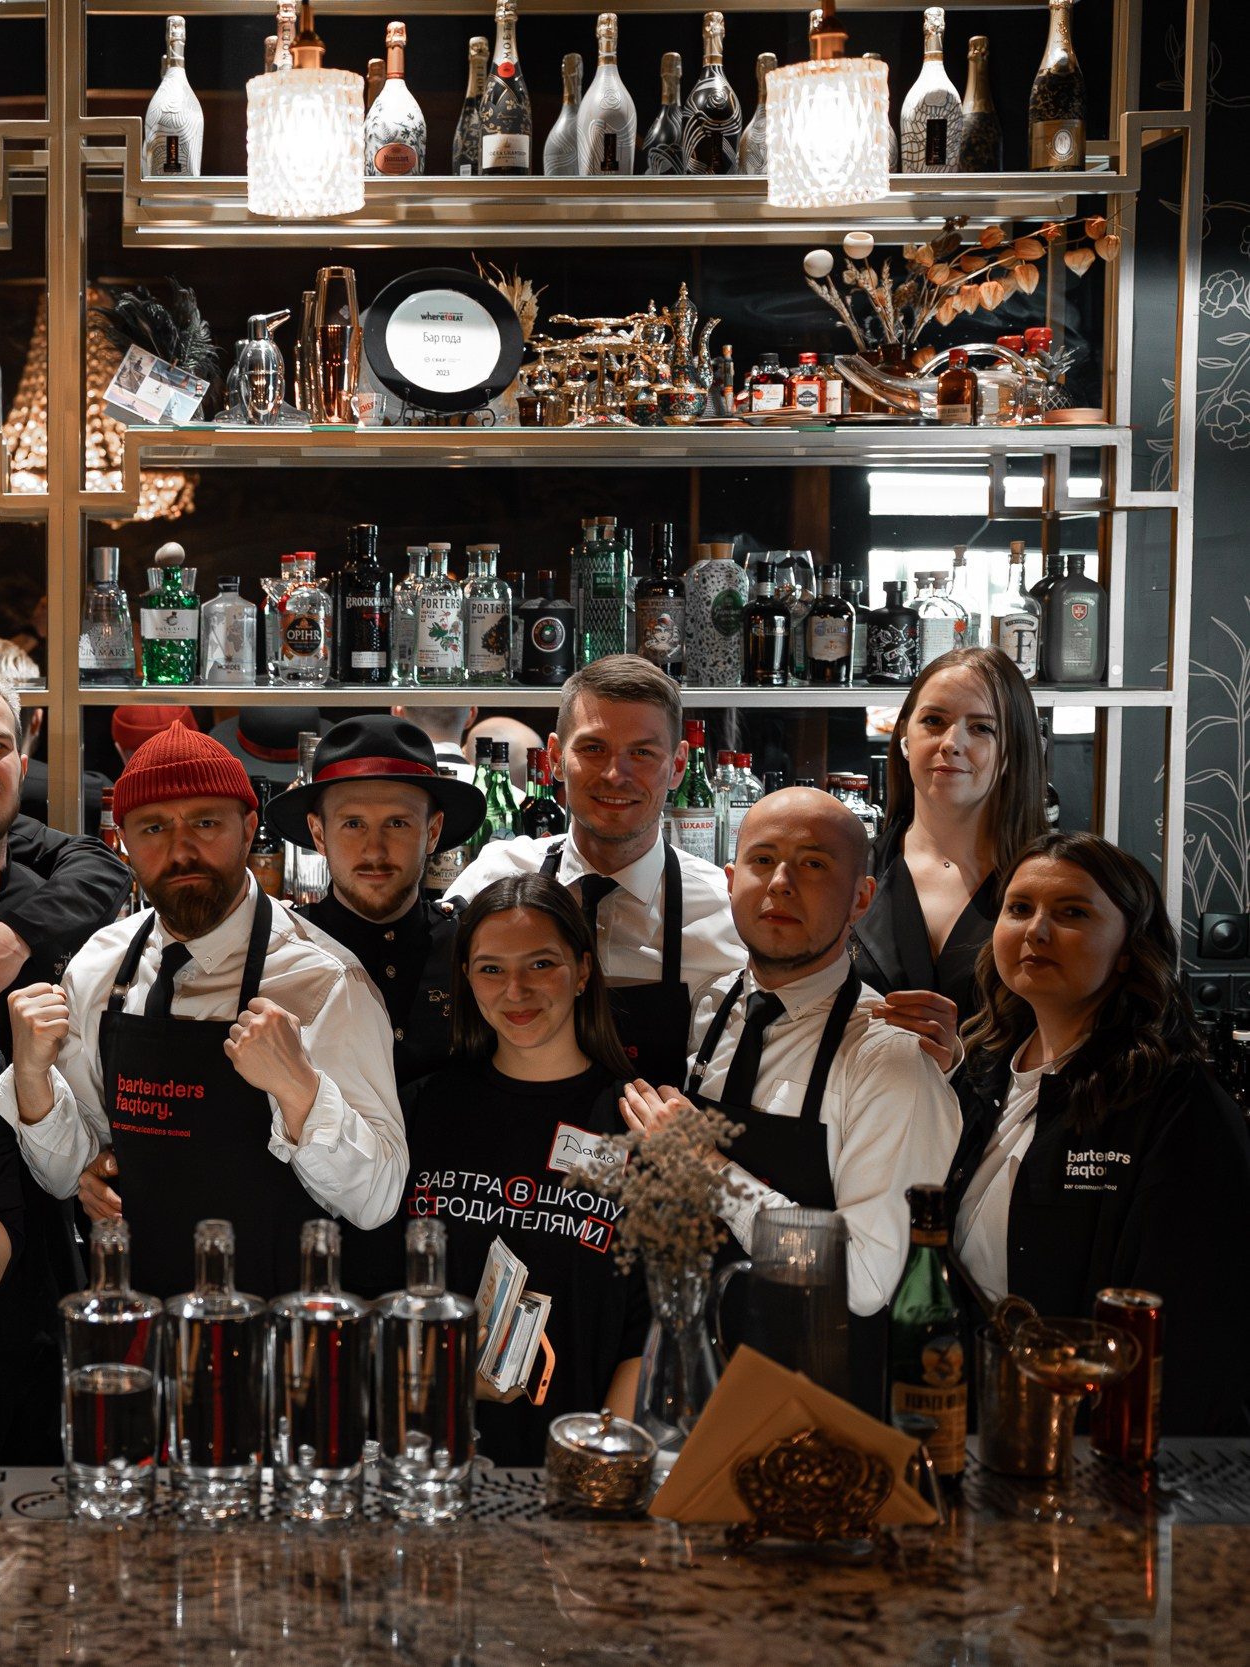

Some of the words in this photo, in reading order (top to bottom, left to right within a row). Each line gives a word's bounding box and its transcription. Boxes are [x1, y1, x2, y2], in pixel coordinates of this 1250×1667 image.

[423, 332, 440, 344] Бар
[442, 335, 462, 344] года
[421, 598, 461, 609] PORTERS
[471, 603, 510, 615] PORTERS
[286, 629, 322, 640] OPIHR
[1012, 629, 1038, 664] F
[679, 821, 713, 829] LUXARDO
[117, 1073, 205, 1099] bartenders
[116, 1092, 173, 1120] faqtory.
[112, 1121, 121, 1129] bar
[121, 1123, 167, 1136] communications
[167, 1129, 191, 1138] school
[1066, 1163, 1107, 1179] faqto
[415, 1171, 503, 1198] ЗАВТРА
[513, 1182, 529, 1203] В
[536, 1184, 625, 1221] ШКОЛУ
[416, 1196, 429, 1216] С
[435, 1195, 605, 1245] РОДИТЕЛЯМИ
